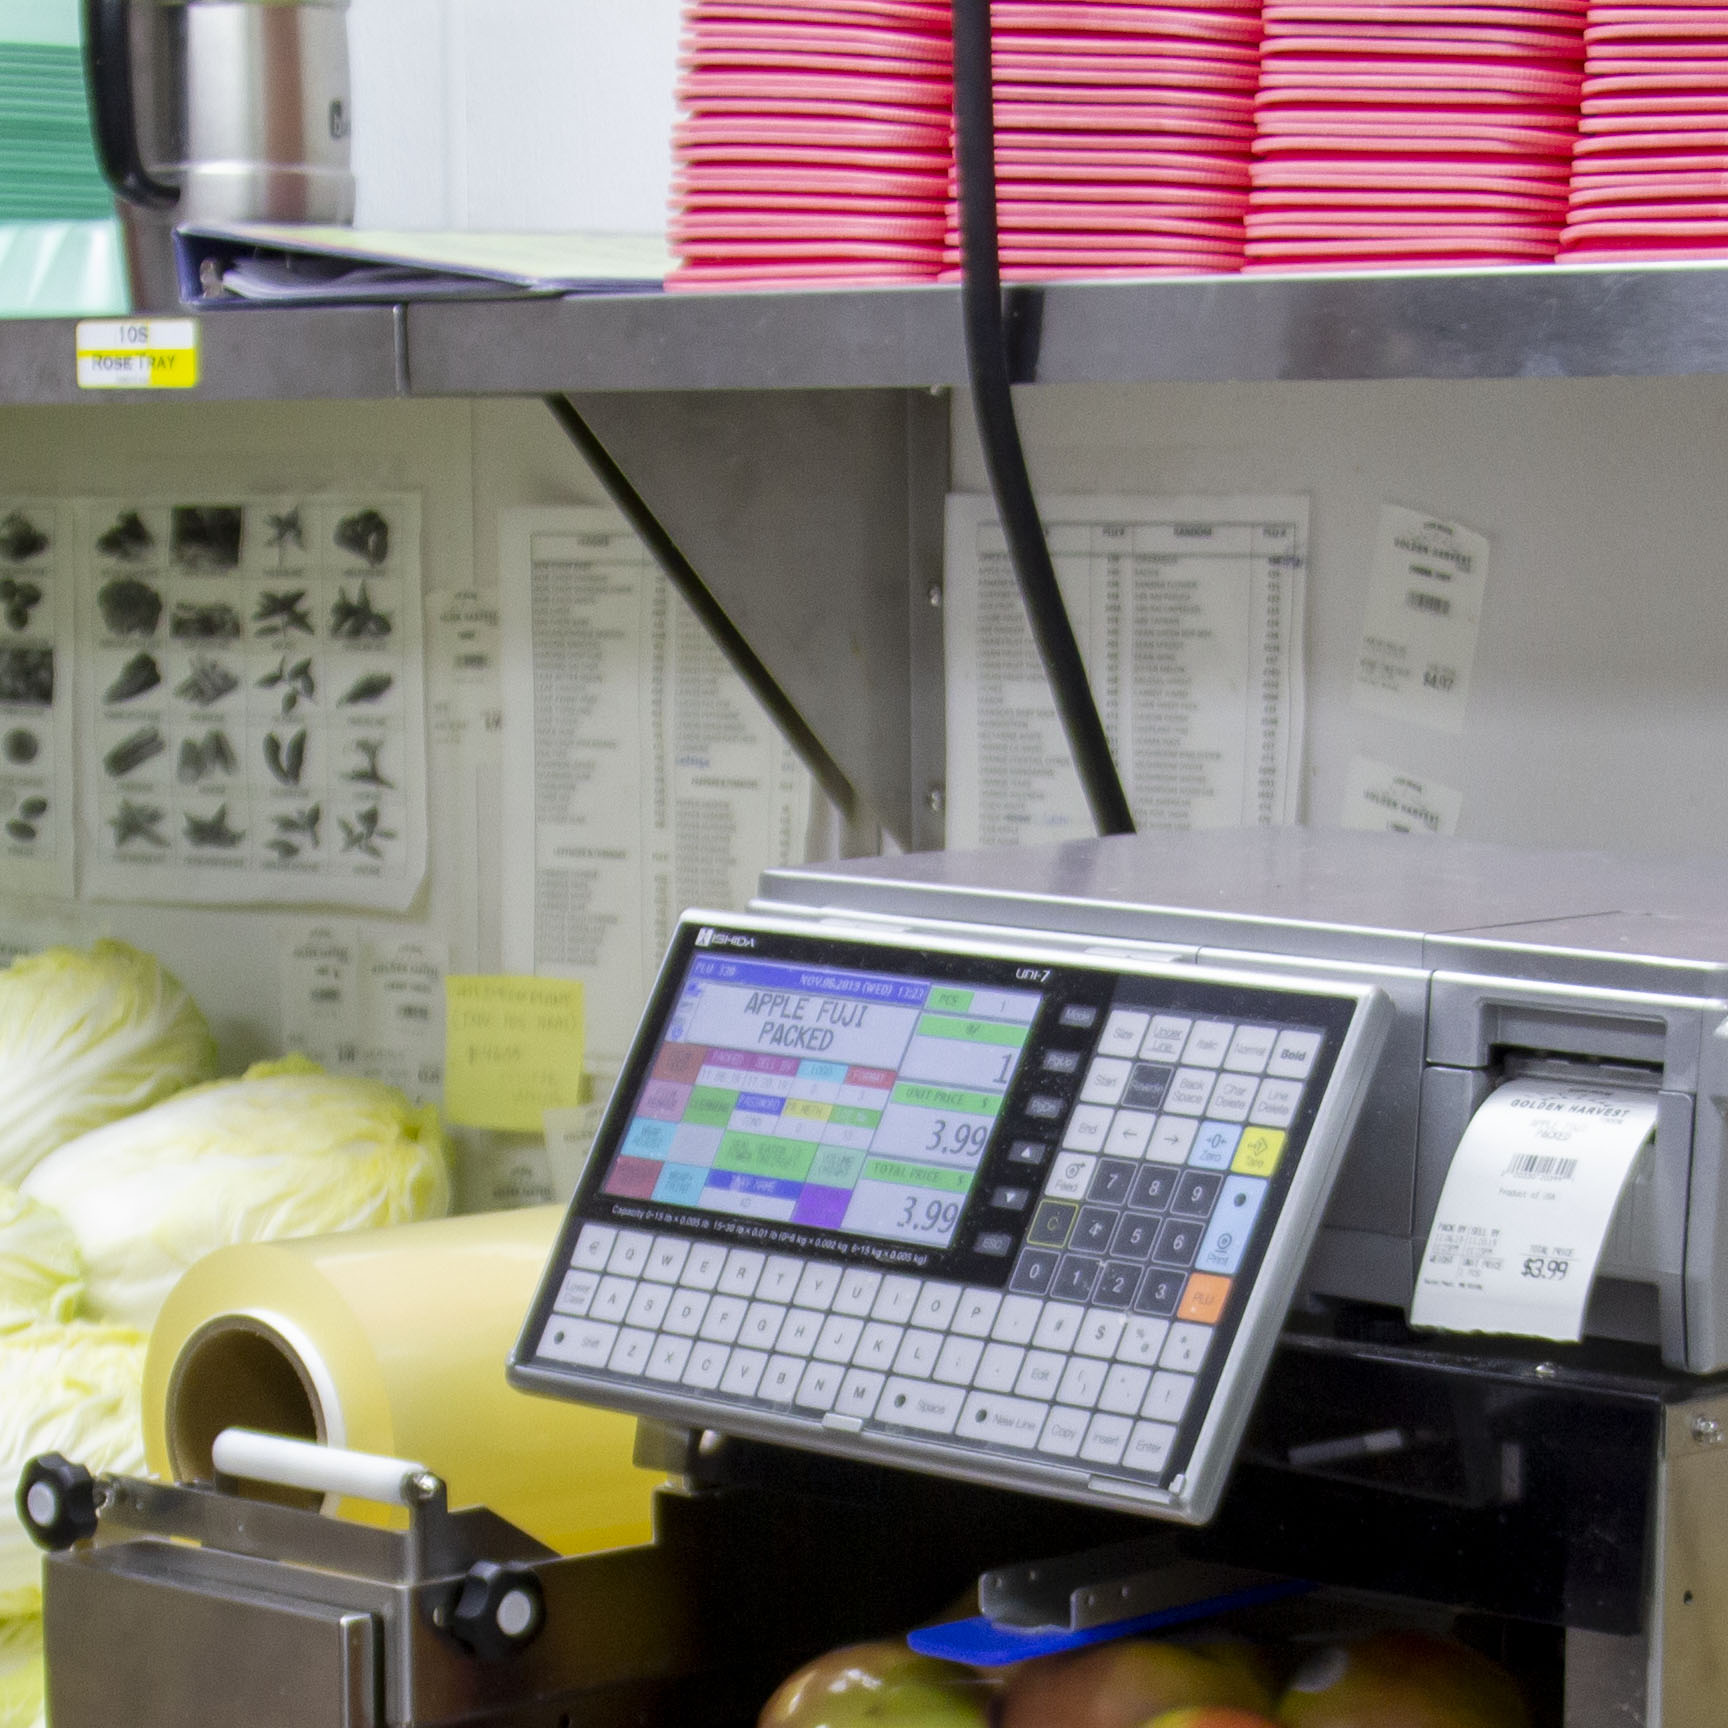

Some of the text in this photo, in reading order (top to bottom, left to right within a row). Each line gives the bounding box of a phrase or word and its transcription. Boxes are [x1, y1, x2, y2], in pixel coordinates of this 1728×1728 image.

[744, 991, 868, 1028] APPLE FUJI
[758, 1021, 834, 1052] PACKED
[1280, 1047, 1307, 1062] Bold
[993, 1053, 1013, 1085] 1
[1510, 1098, 1631, 1118] GOLDEN HARVEST
[925, 1119, 989, 1157] 3.99
[873, 1160, 907, 1178] TOTAL
[1107, 1174, 1118, 1189] 7
[1149, 1180, 1161, 1196] 8
[1191, 1186, 1203, 1202] 9
[896, 1195, 959, 1234] 3.99
[1130, 1228, 1142, 1243] 5
[1173, 1234, 1185, 1250] 6
[1029, 1263, 1040, 1279] 0
[1521, 1257, 1569, 1281] $3.99
[1073, 1270, 1080, 1285] 1
[1112, 1277, 1124, 1293] 2
[1155, 1283, 1167, 1299] 3
